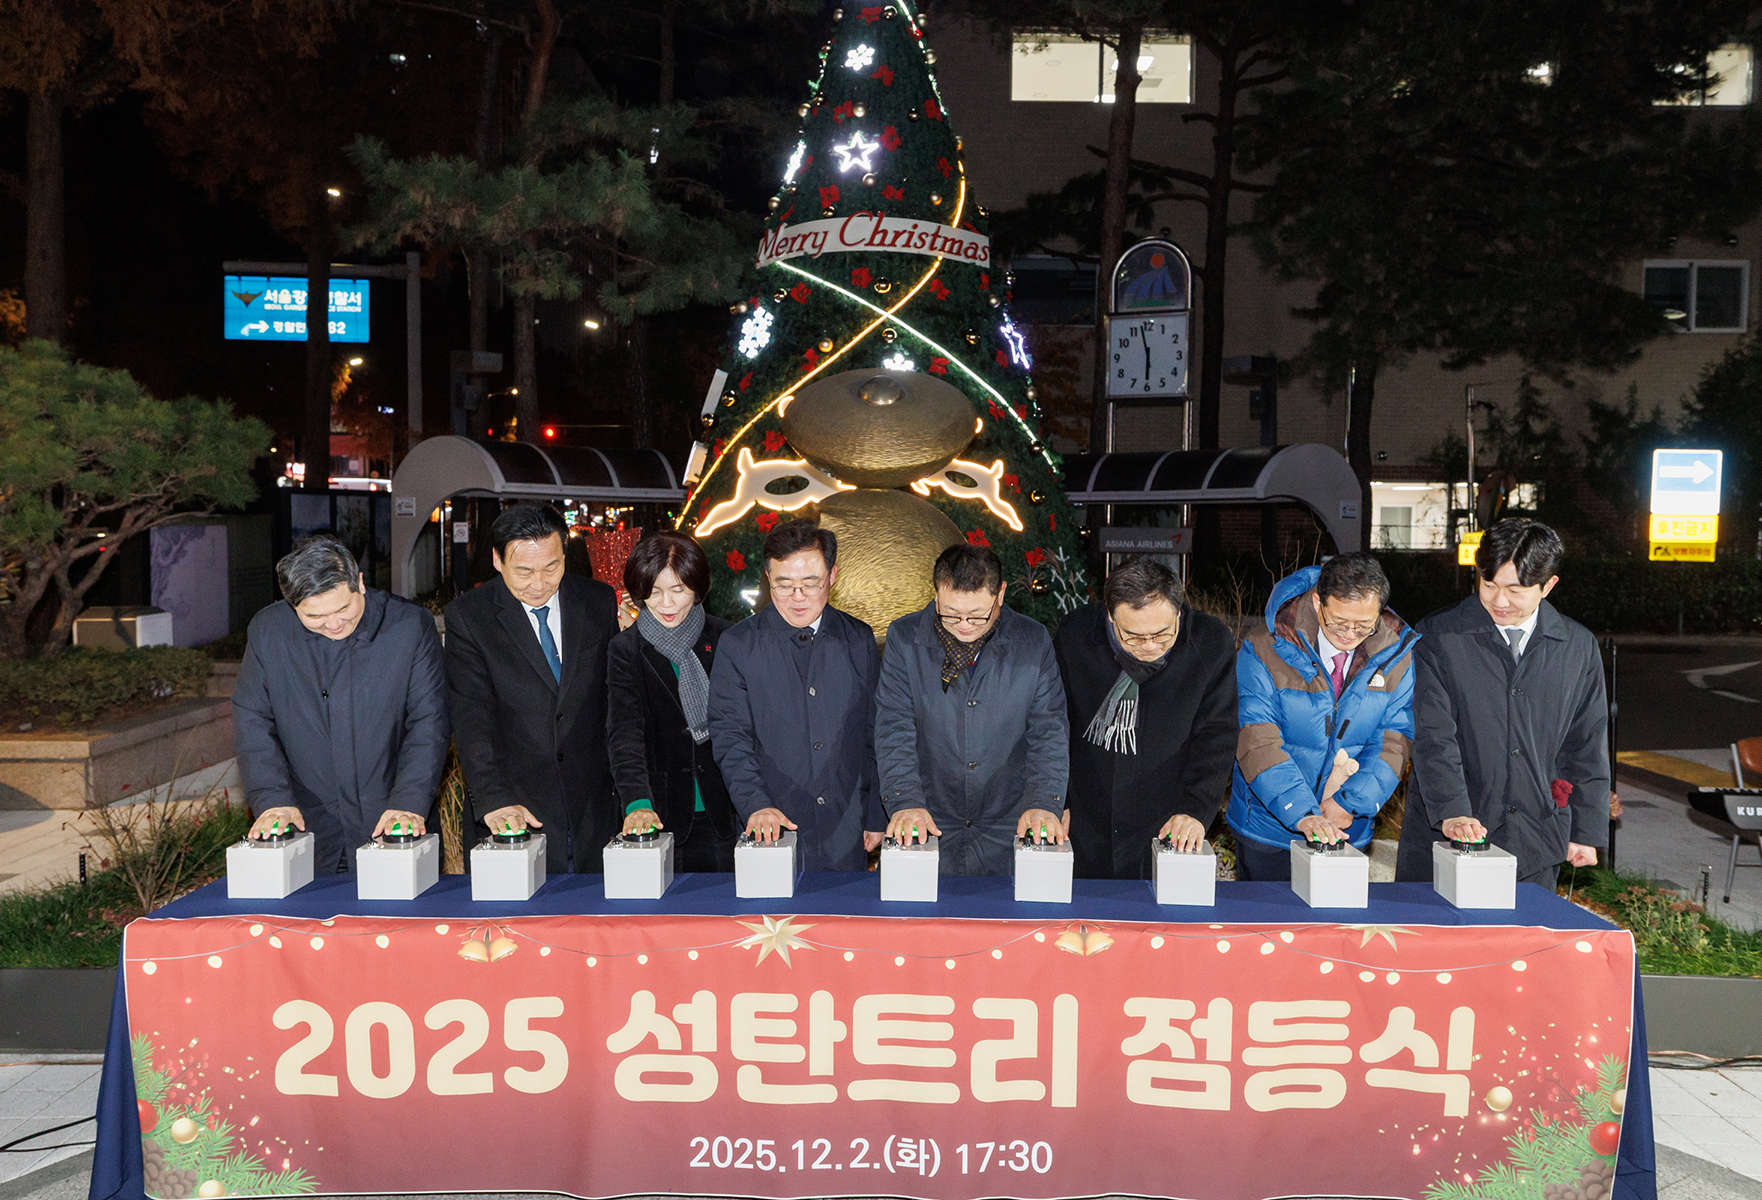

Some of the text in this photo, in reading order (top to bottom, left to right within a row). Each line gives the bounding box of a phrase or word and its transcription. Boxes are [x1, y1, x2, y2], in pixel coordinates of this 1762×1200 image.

[755, 210, 991, 263] Merry Christmas
[1130, 326, 1138, 337] 11
[1143, 322, 1154, 331] 12
[1161, 324, 1165, 334] 1
[1119, 338, 1129, 348] 10
[1172, 334, 1179, 343] 2
[1114, 353, 1120, 363] 9
[1176, 350, 1182, 360] 3
[1118, 369, 1124, 378] 8
[1171, 367, 1177, 376] 4
[1130, 378, 1137, 388] 7
[1144, 382, 1150, 391] 6
[1159, 378, 1165, 387] 5
[1655, 520, 1714, 536] 후진금지
[1105, 540, 1173, 549] ASIANA AIRLINES
[272, 990, 1475, 1117] 2025 성탄트리 점등식
[689, 1135, 1053, 1178] 2025.12.2.(화) 17:30
